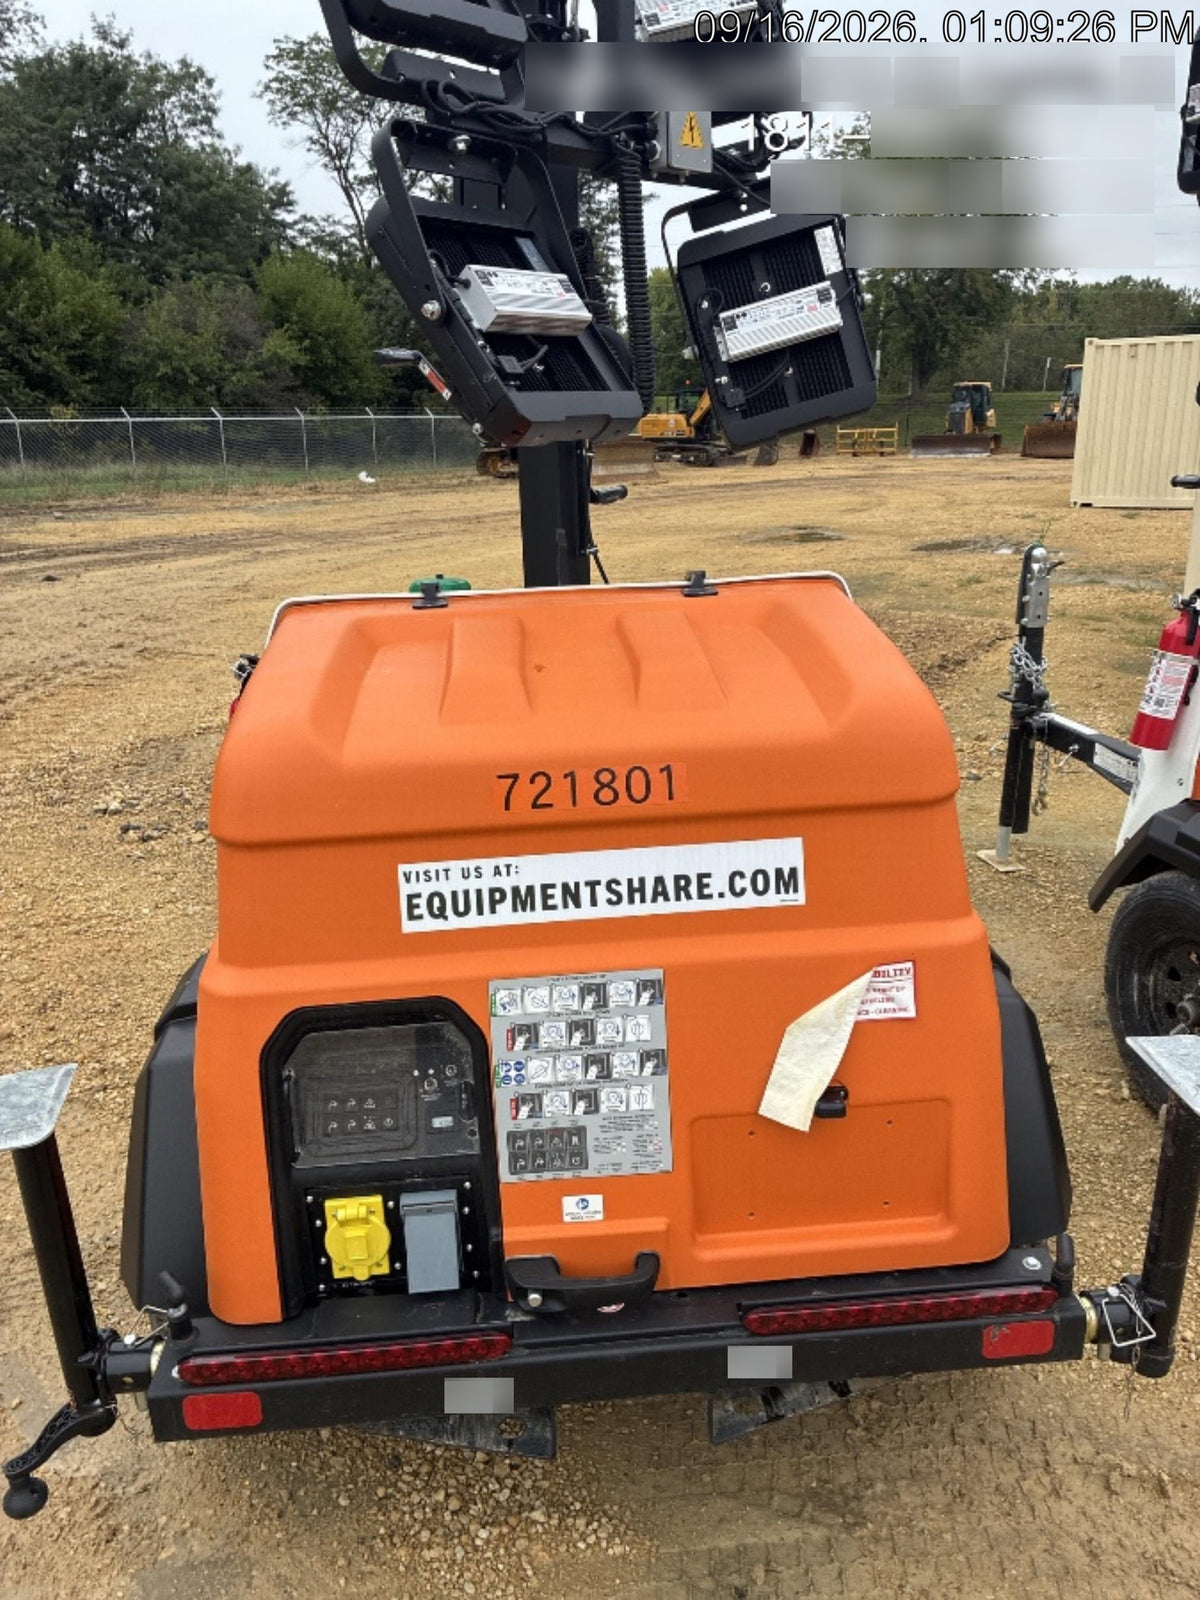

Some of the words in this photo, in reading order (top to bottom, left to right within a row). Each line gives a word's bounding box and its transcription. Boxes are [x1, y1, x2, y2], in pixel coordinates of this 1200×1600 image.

[496, 763, 674, 811] 721801
[403, 868, 452, 884] VISIT
[461, 865, 484, 880] US
[493, 863, 520, 878] AT:
[406, 866, 799, 922] EQUIPMENTSHARE.COM
